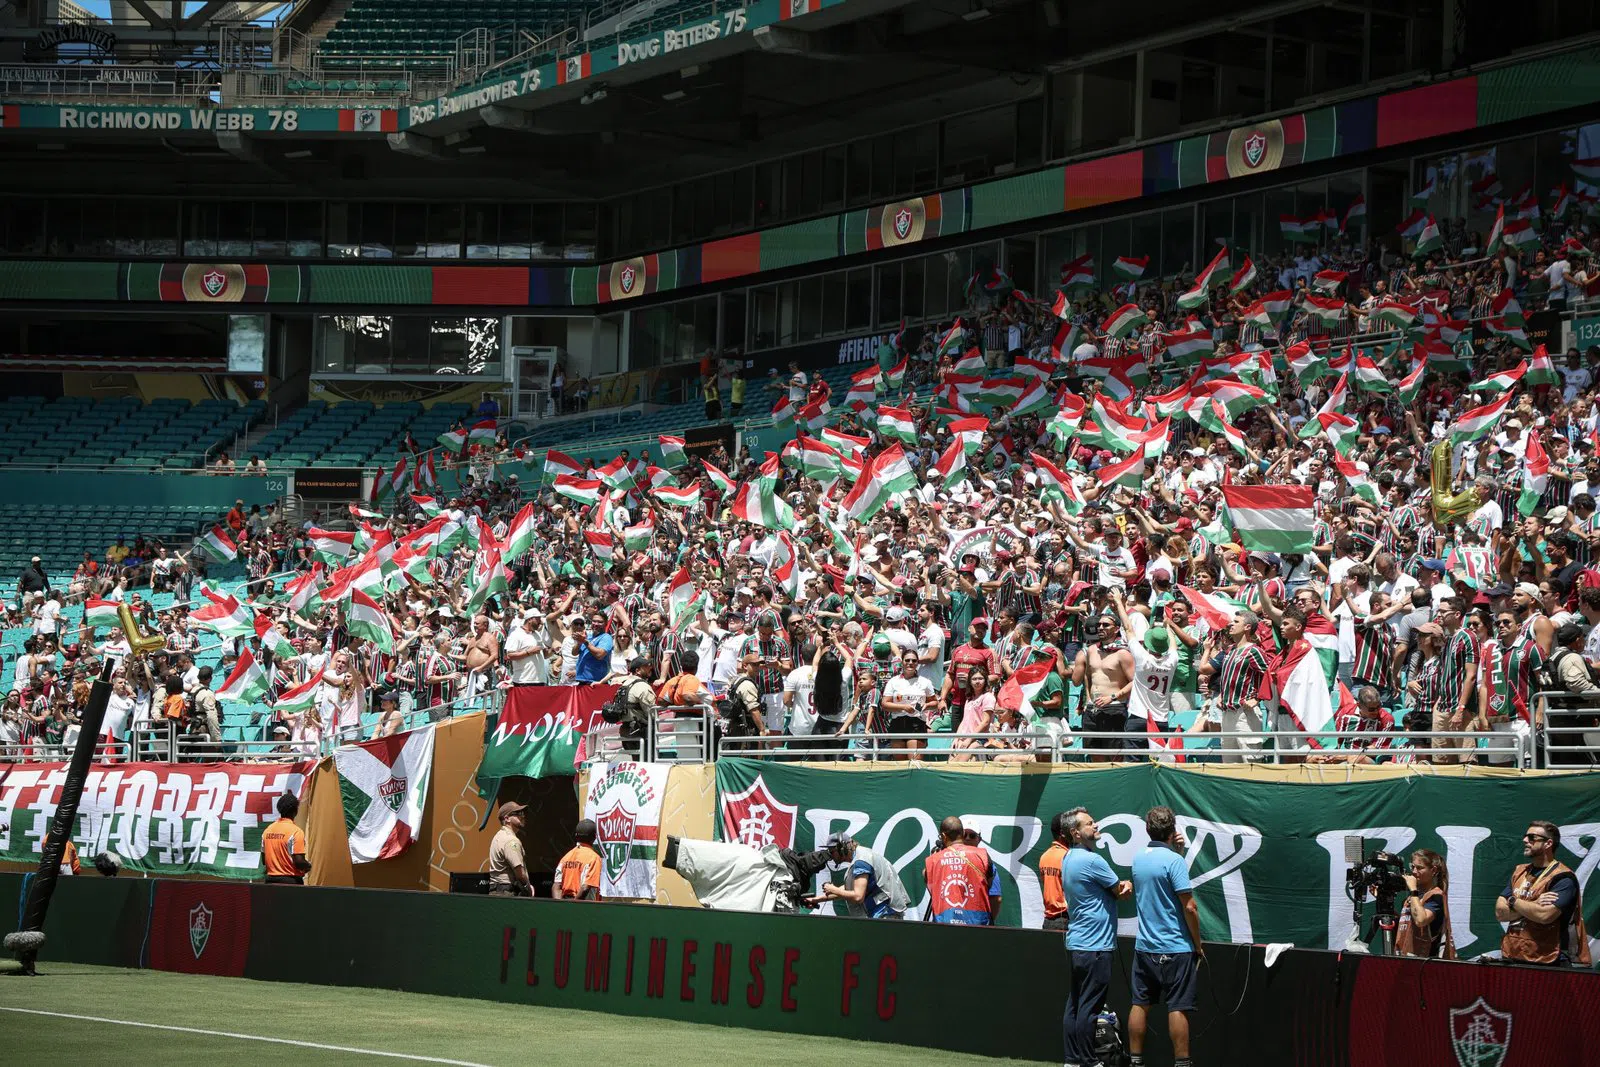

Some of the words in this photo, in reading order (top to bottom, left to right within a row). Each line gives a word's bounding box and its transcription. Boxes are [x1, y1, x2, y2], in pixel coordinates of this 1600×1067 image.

[618, 38, 660, 66] DOUG
[664, 20, 721, 54] BETTERS
[724, 8, 748, 36] 75
[409, 105, 436, 127] BOB
[438, 80, 518, 118] BAUMHOWER
[521, 69, 542, 95] 73
[60, 108, 182, 130] RICHMOND
[190, 109, 255, 131] WEBB
[268, 110, 299, 132] 78
[745, 435, 759, 447] 130
[265, 481, 284, 491] 126
[1147, 675, 1169, 696] 21
[500, 926, 801, 1013] FLUMINENSE
[841, 951, 899, 1021] FC
